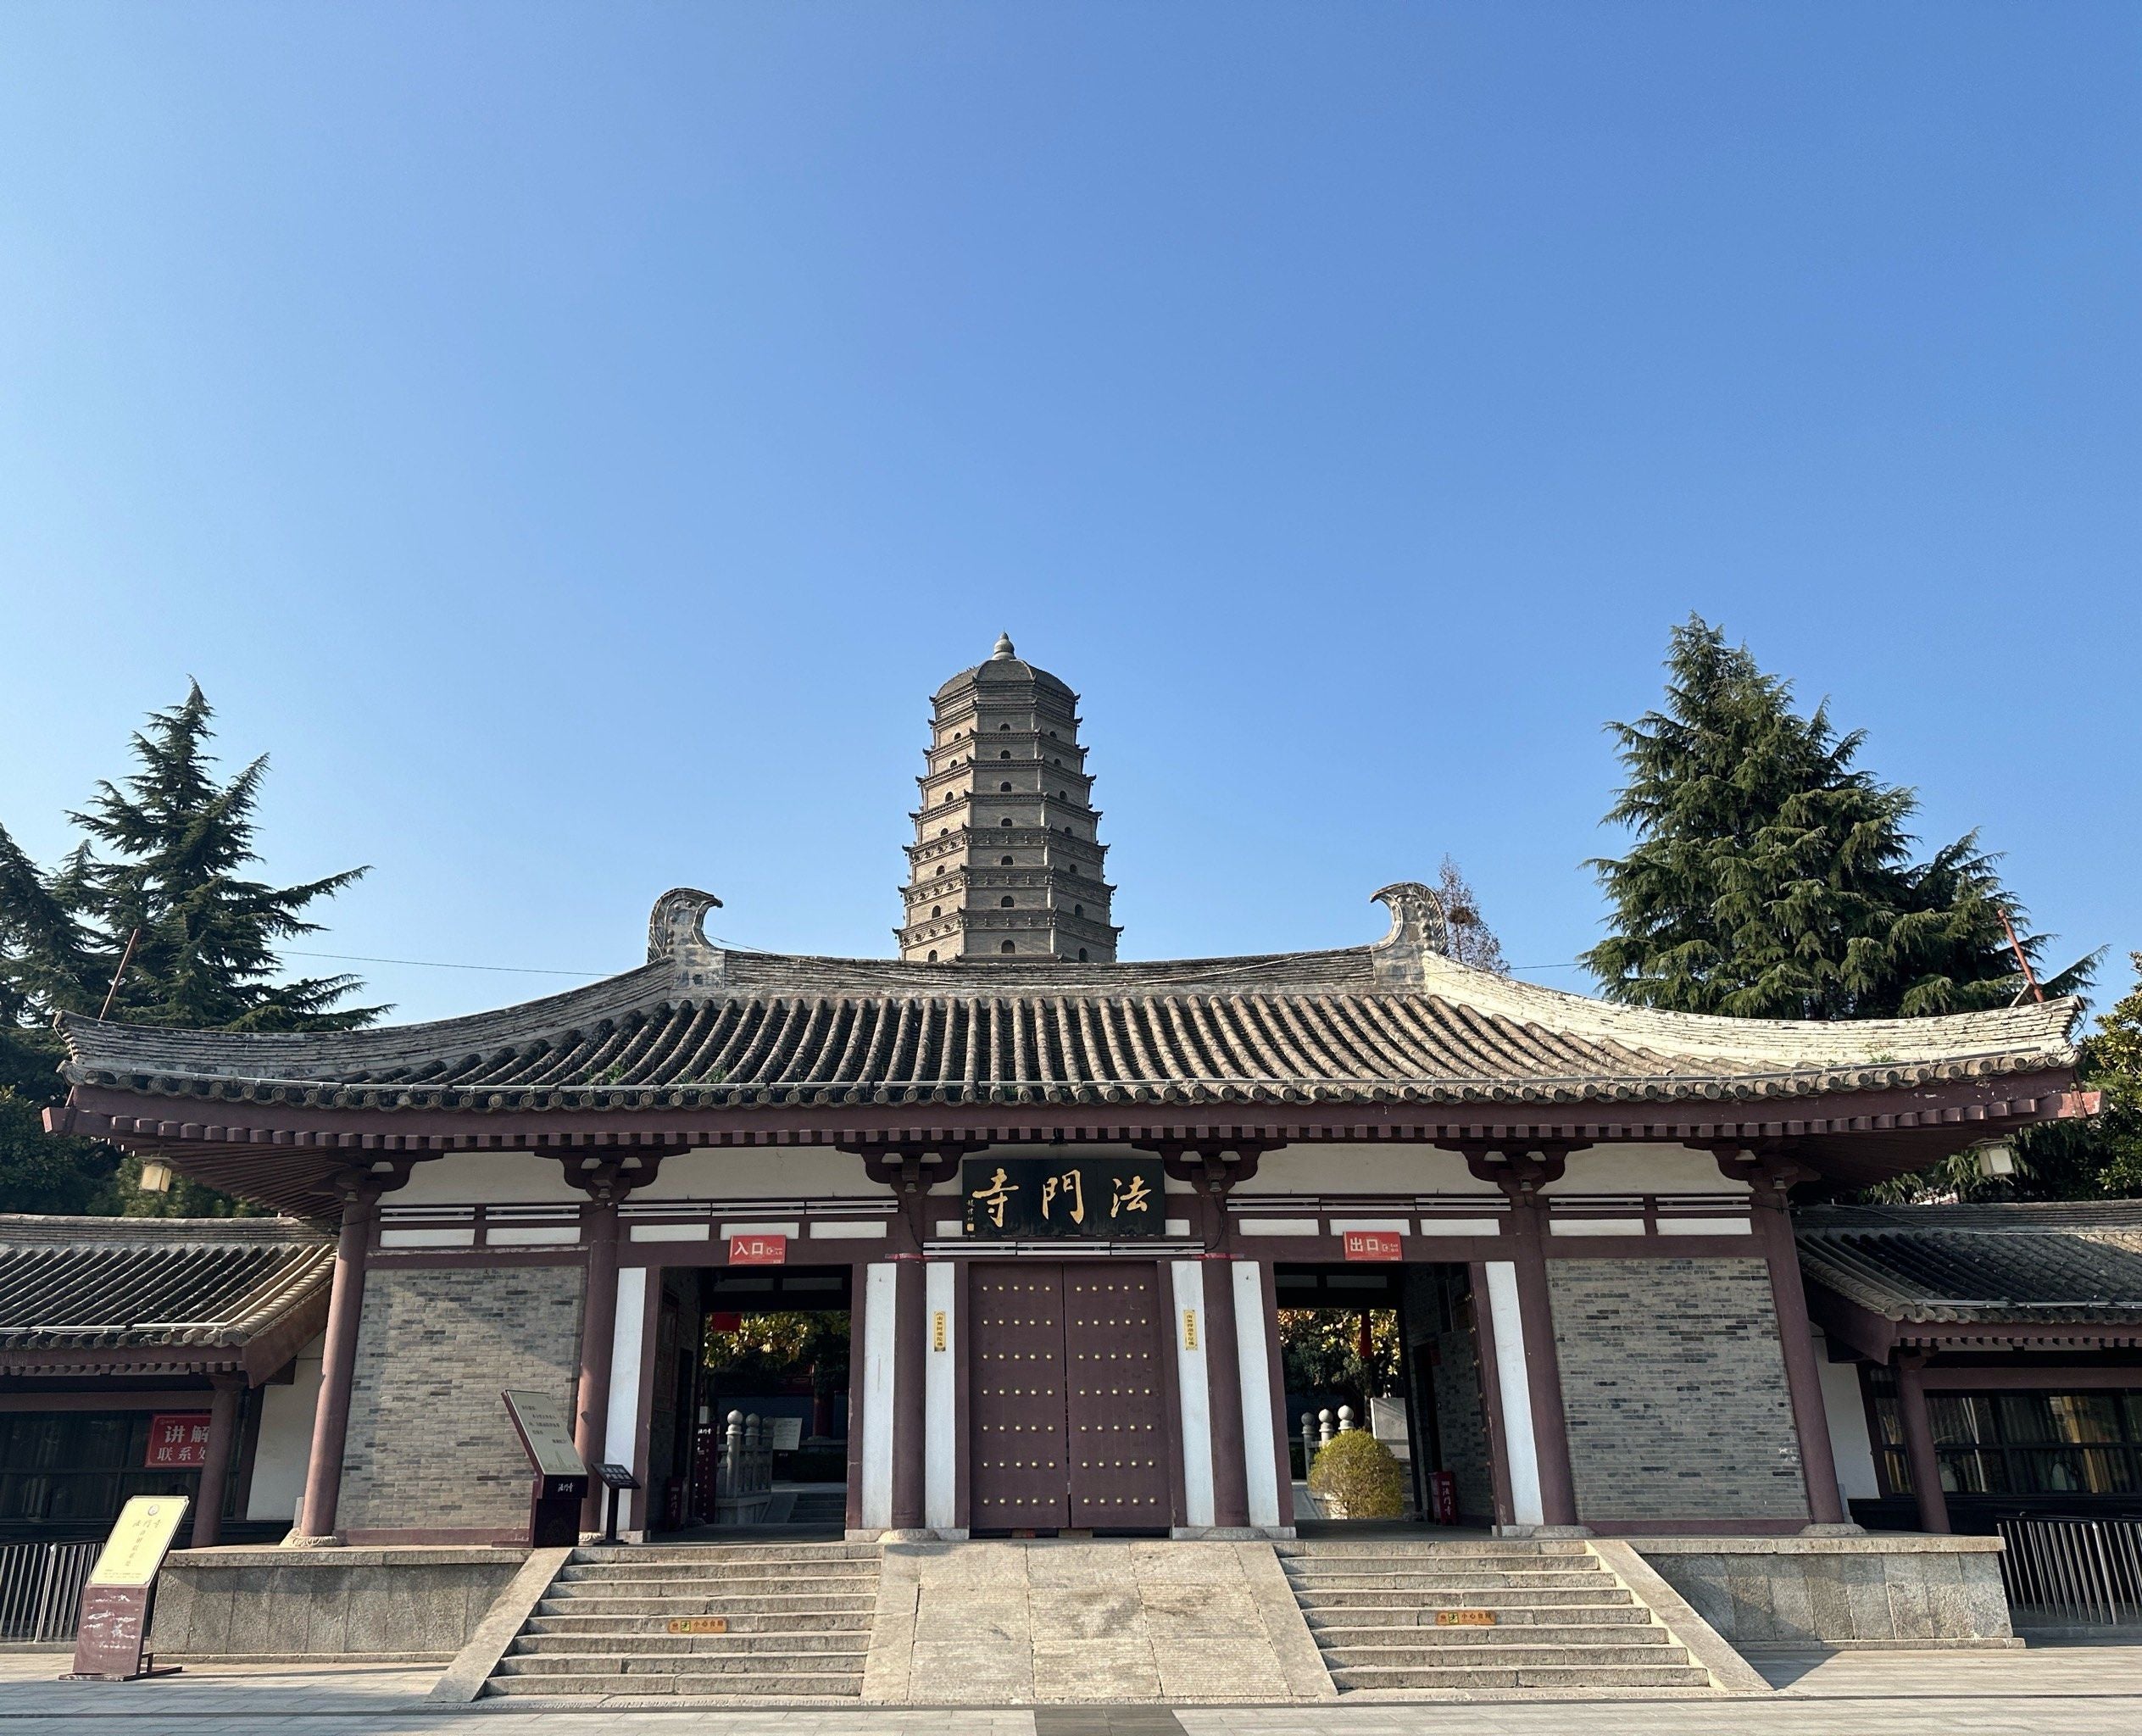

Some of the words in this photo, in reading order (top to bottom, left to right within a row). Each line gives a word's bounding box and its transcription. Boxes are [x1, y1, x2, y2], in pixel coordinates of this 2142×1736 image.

[734, 1241, 764, 1255] 入口
[1349, 1237, 1379, 1252] 出口
[164, 1425, 210, 1443] 讲解
